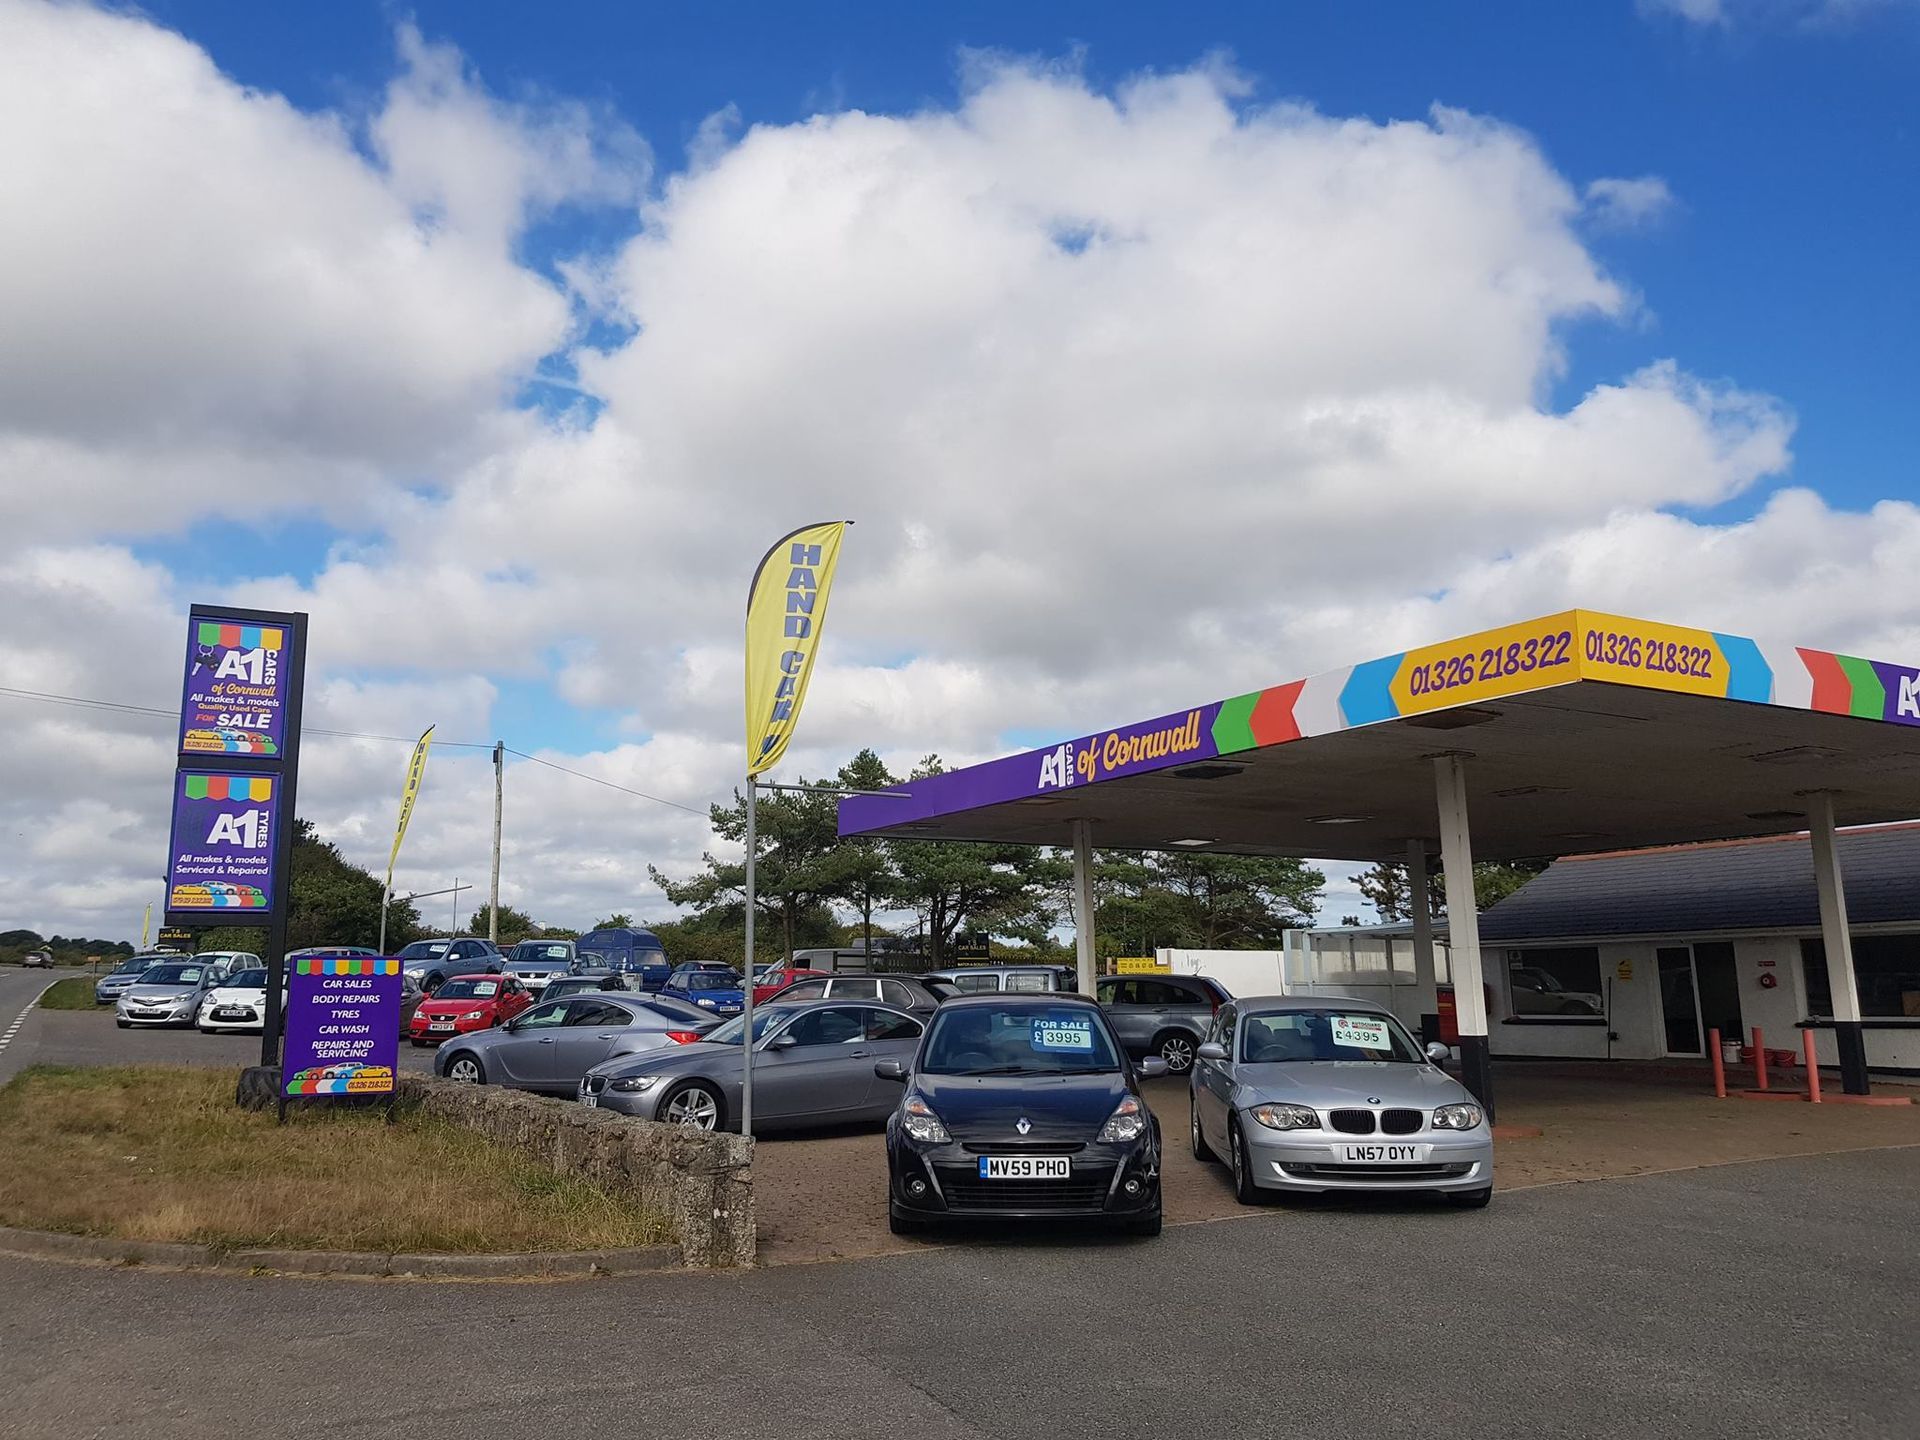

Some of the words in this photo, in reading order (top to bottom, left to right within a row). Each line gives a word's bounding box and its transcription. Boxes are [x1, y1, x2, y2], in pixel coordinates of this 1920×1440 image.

[783, 543, 822, 639] HAND
[1585, 629, 1642, 668] 01326
[1646, 639, 1712, 679] 218322
[214, 647, 265, 685] A1
[264, 649, 278, 685] CARS
[1410, 653, 1475, 697] 01326
[1478, 631, 1572, 682] 218322
[211, 681, 225, 695] of
[226, 683, 277, 697] Cornwall
[770, 650, 804, 723] CAR
[190, 693, 204, 701] All
[204, 695, 235, 703] makes
[236, 696, 245, 704] &
[247, 699, 280, 707] models
[198, 702, 228, 712] Quality
[229, 704, 250, 712] Used
[195, 713, 216, 722] FOR
[216, 713, 272, 729] SALE
[1038, 744, 1066, 789] A1
[1065, 742, 1074, 786] CARS
[1076, 737, 1101, 782] of
[1102, 710, 1201, 772] Cornwall
[206, 809, 259, 849] A1
[258, 810, 270, 849] TYRES
[179, 854, 192, 863] All
[193, 855, 223, 863] makes
[225, 855, 233, 864] &
[235, 856, 267, 864] models
[175, 865, 215, 874] Serviced
[216, 865, 225, 874] &
[227, 866, 269, 876] Repaired
[322, 979, 343, 988] CAR
[344, 979, 373, 988] SALES
[312, 995, 341, 1004] BODY
[341, 994, 381, 1004] REPAIRS
[331, 1010, 360, 1019] TYRES
[318, 1025, 339, 1034] CAR
[340, 1025, 370, 1034] WASH
[1034, 1020, 1057, 1029] FOR
[1060, 1021, 1090, 1030] SALE
[1046, 1032, 1081, 1043] 3995
[1335, 1030, 1380, 1042] £4395
[311, 1040, 351, 1049] REPAIRS
[352, 1039, 375, 1049] AND
[316, 1048, 369, 1058] SERVICING
[1346, 1146, 1385, 1161] LN57
[1388, 1146, 1416, 1160] OYY
[989, 1160, 1032, 1176] MV59
[1035, 1160, 1067, 1176] PHO
